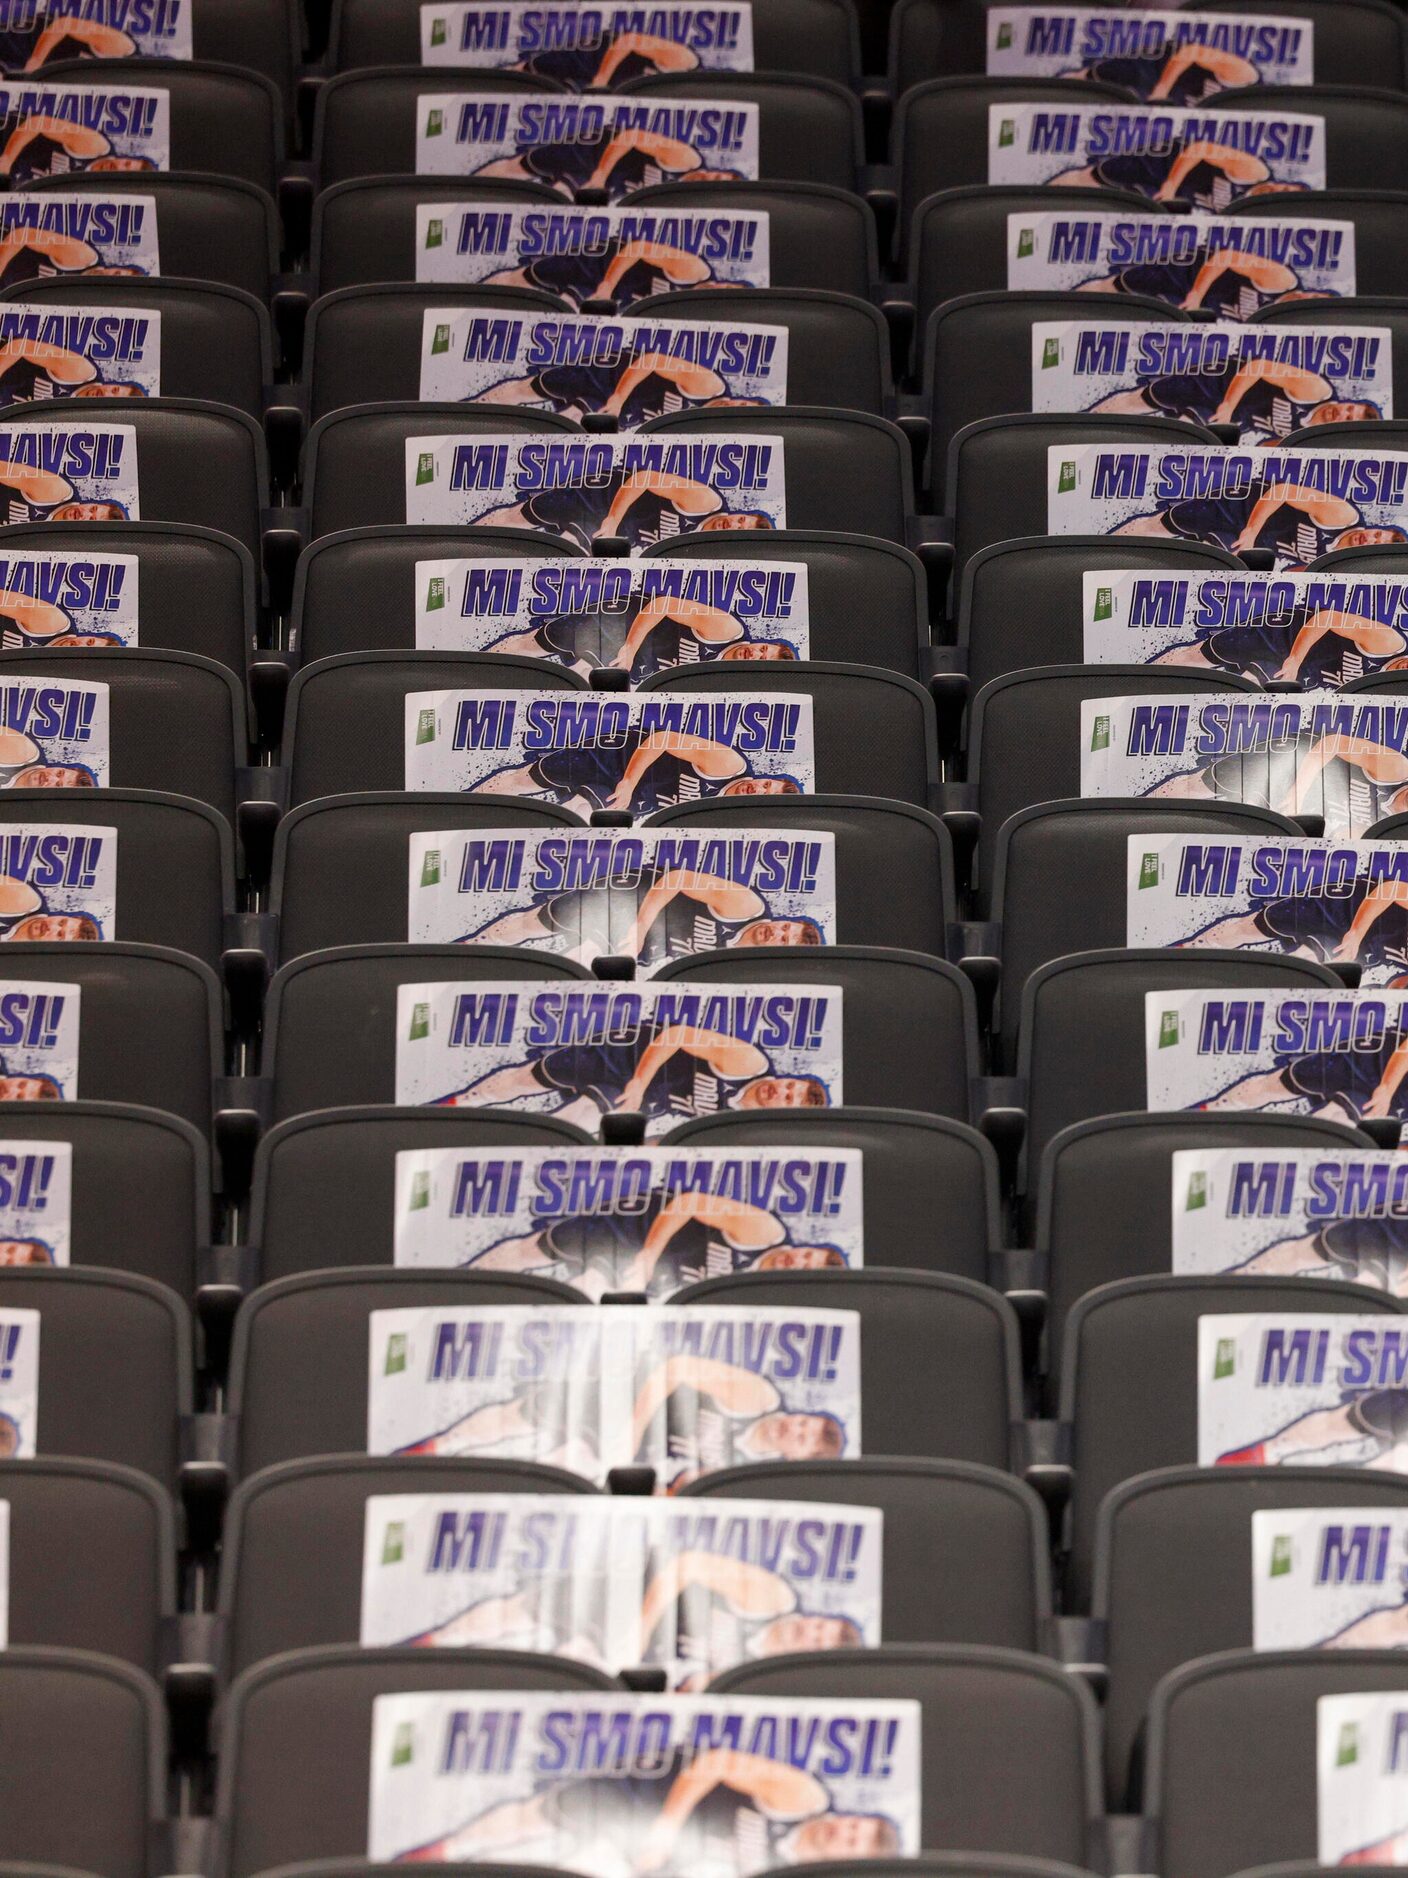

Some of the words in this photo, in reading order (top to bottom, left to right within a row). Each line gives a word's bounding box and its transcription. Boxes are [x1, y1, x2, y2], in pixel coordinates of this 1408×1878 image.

[45, 0, 180, 37] MAVSI!
[460, 10, 511, 53] MI
[516, 10, 602, 51] SMO
[610, 11, 742, 50] MAVSI!
[1025, 16, 1077, 58] MI
[1080, 17, 1166, 60] SMO
[1173, 22, 1303, 66] MAVSI!
[17, 93, 159, 137] MAVSI!
[456, 102, 511, 144] MI
[514, 103, 604, 145] SMO
[611, 107, 748, 150] MAVSI!
[1028, 112, 1082, 155] MI
[1085, 114, 1174, 157] SMO
[1180, 119, 1315, 164] MAVSI!
[1, 204, 145, 246] MAVSI!
[456, 212, 513, 256] MI
[517, 213, 610, 256] SMO
[617, 217, 759, 262] MAVSI!
[1048, 221, 1103, 265] MI
[1107, 222, 1198, 266] SMO
[1206, 226, 1344, 271] MAVSI!
[0, 314, 150, 361] MAVSI!
[463, 318, 524, 364] MI
[525, 321, 624, 368] SMO
[629, 328, 777, 378] MAVSI!
[1073, 331, 1131, 376] MI
[1135, 331, 1229, 376] SMO
[1237, 335, 1381, 380] MAVSI!
[450, 444, 509, 492] MI
[514, 444, 613, 490] SMO
[622, 445, 773, 490] MAVSI!
[1091, 454, 1150, 500] MI
[1154, 454, 1252, 500] SMO
[1260, 458, 1408, 505] MAVSI!
[0, 561, 127, 611] AVSI!
[461, 568, 523, 617] MI
[528, 568, 631, 615] SMO
[640, 570, 797, 618] MAVSI!
[1128, 580, 1189, 628] MI
[1194, 580, 1295, 628] SMO
[452, 700, 517, 751] MI
[522, 700, 629, 749] SMO
[638, 703, 801, 752] MAVSI!
[1126, 704, 1190, 756] MI
[1195, 704, 1300, 754] SMO
[458, 839, 526, 894] MI
[531, 839, 643, 891] SMO
[652, 841, 823, 892] MAVSI!
[1176, 845, 1242, 898] MI
[1247, 846, 1358, 899] SMO
[448, 993, 520, 1048] MI
[524, 992, 642, 1046] SMO
[651, 996, 829, 1050] MAVSI!
[1197, 1000, 1266, 1056] MI
[1272, 1000, 1386, 1054] SMO
[450, 1159, 524, 1219] MI
[529, 1159, 652, 1216] SMO
[662, 1161, 849, 1217] MAVSI!
[1226, 1161, 1298, 1220] MI
[1255, 1328, 1332, 1390] MI
[1313, 1523, 1392, 1589] MI
[436, 1708, 525, 1777] MI
[530, 1708, 674, 1776] SMO
[684, 1714, 904, 1782] MAVSI!
